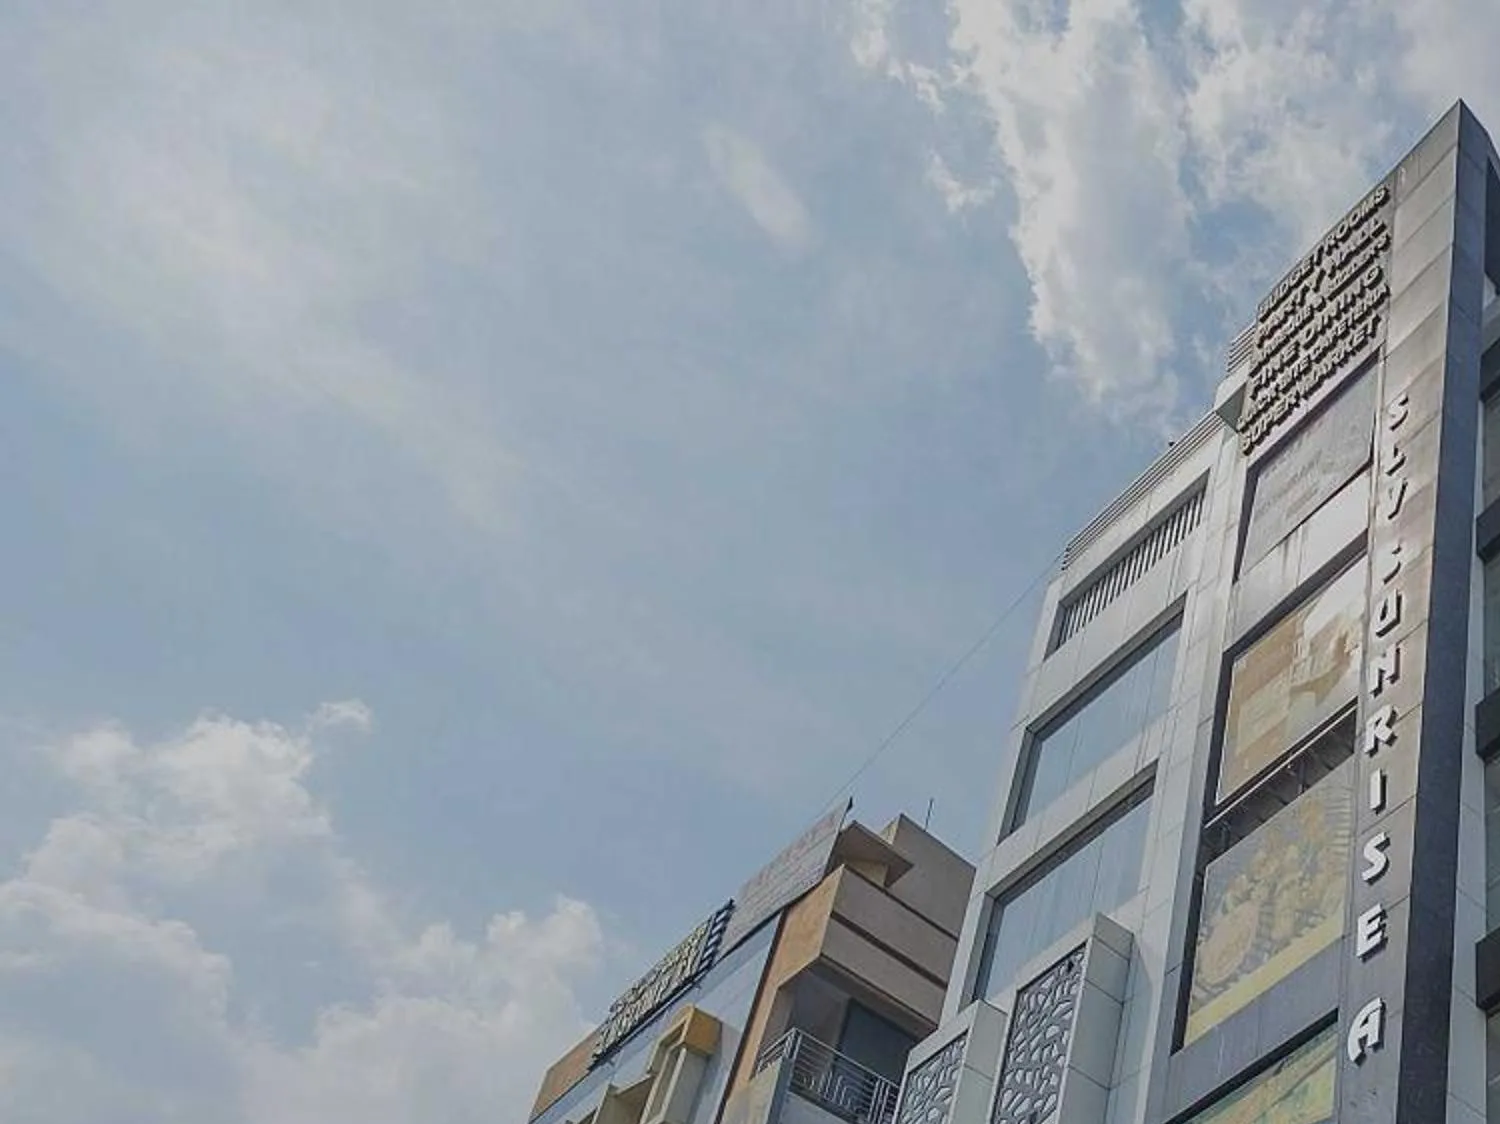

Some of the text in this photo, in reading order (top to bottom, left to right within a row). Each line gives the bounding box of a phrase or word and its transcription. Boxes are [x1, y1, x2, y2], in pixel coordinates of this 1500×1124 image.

[1324, 184, 1388, 254] ROOMS
[1238, 312, 1381, 455] SUPER MARKET
[1250, 341, 1300, 397] FINE
[1302, 265, 1383, 348] DINING
